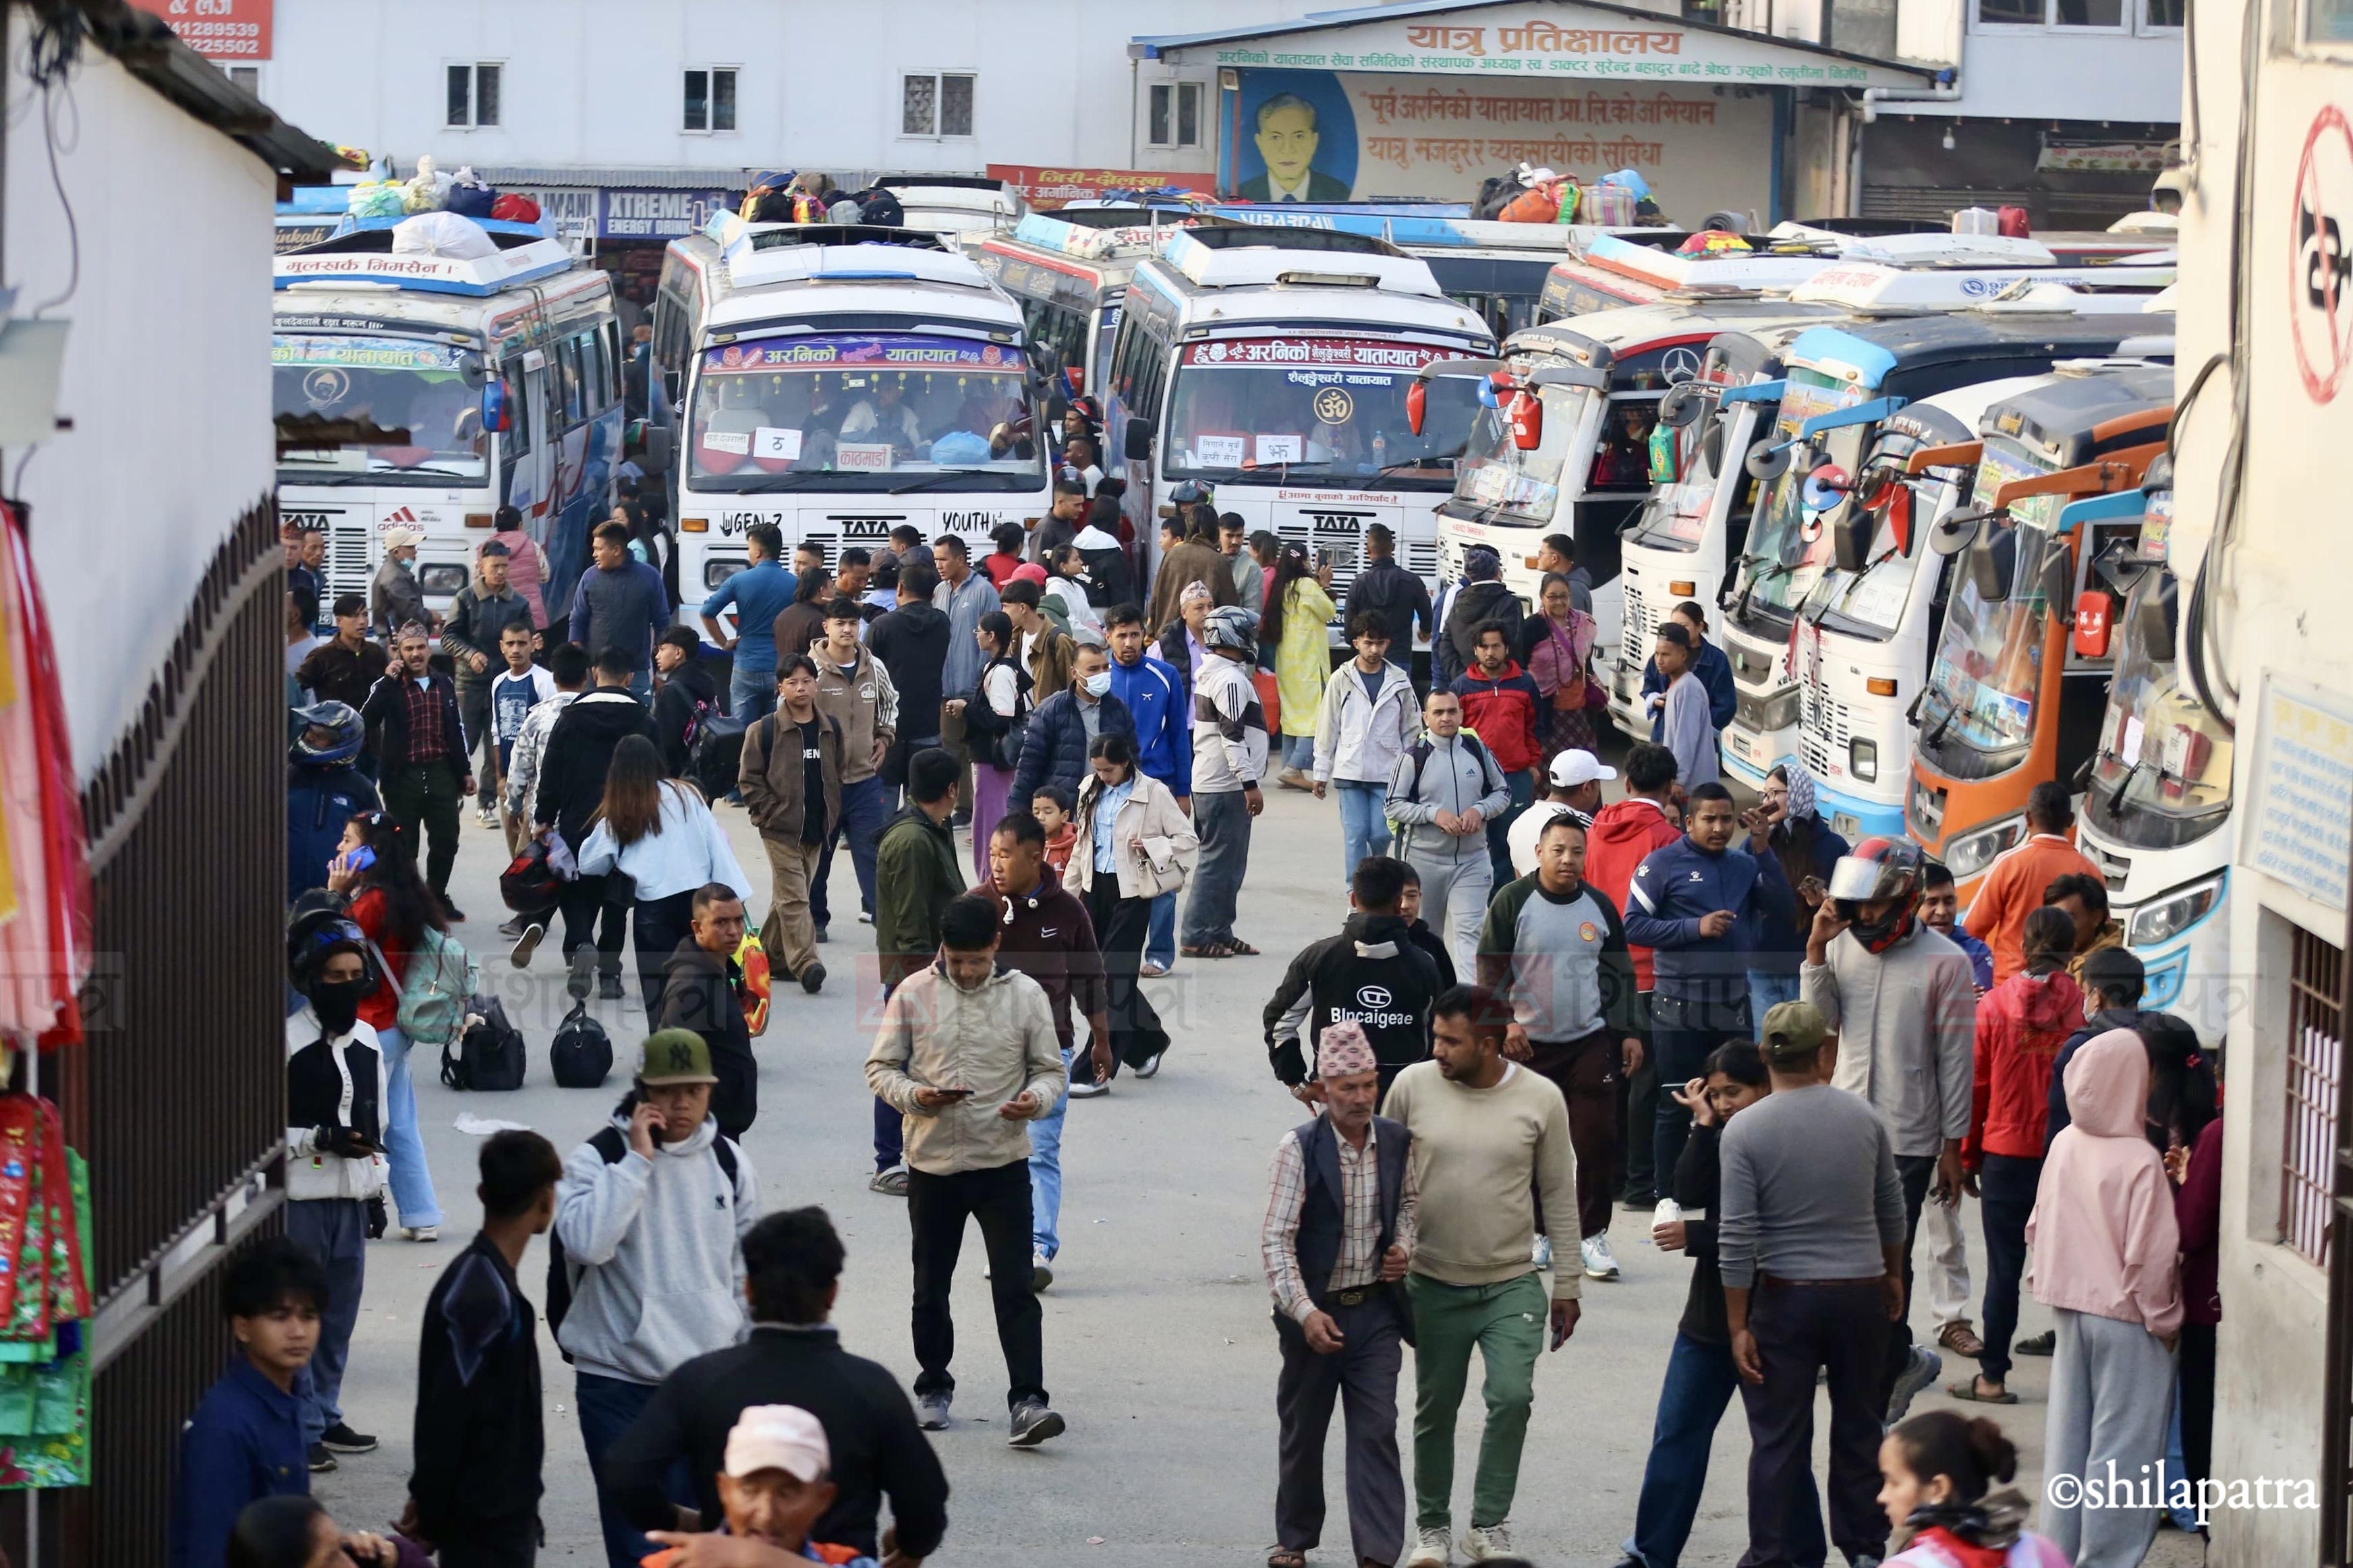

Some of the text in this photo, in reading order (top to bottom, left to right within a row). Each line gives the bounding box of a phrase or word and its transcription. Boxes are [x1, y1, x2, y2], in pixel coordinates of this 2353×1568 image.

[167, 21, 259, 37] 41289539
[182, 38, 259, 53] 5225502
[1407, 21, 1683, 57] यात्रु प्रतिक्षालय
[1216, 49, 1268, 65] अरनिको
[1273, 54, 1326, 66] यातायात
[608, 193, 691, 219] XTREME
[607, 219, 692, 235] ENERGY DRINK
[275, 227, 326, 245] inkali
[272, 343, 295, 361] को
[764, 345, 839, 364] अरनिको
[885, 348, 959, 363] यातायात
[1246, 339, 1310, 361] अरनिको
[1353, 347, 1419, 366] यातायात
[1345, 374, 1393, 386] यातायात
[283, 515, 330, 531] TATA
[842, 521, 890, 534] TATA
[942, 512, 990, 532] YOUTH
[1313, 516, 1360, 529] TATA
